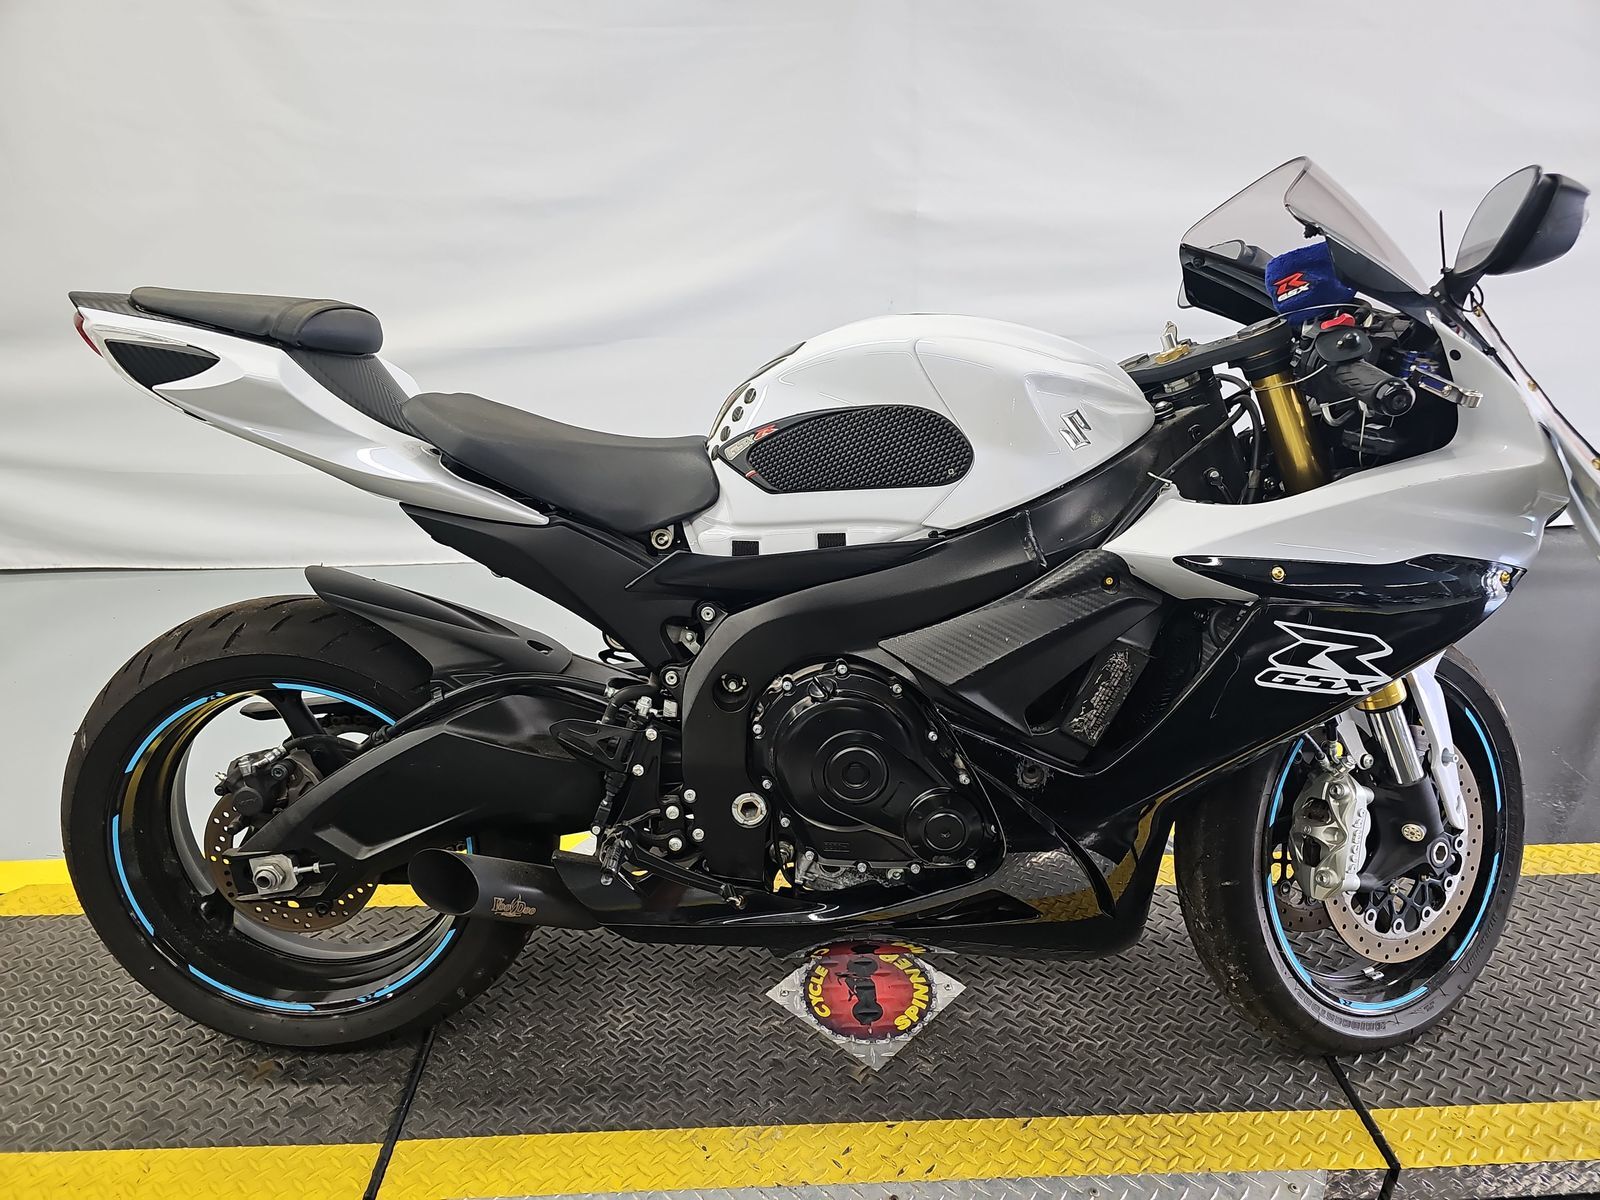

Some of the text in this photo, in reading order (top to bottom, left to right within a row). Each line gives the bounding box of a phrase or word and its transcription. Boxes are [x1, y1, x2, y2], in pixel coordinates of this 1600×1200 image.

[1273, 272, 1308, 295] R
[1269, 620, 1393, 683] R
[1255, 667, 1372, 695] GSX
[807, 964, 831, 1018] CYCLE
